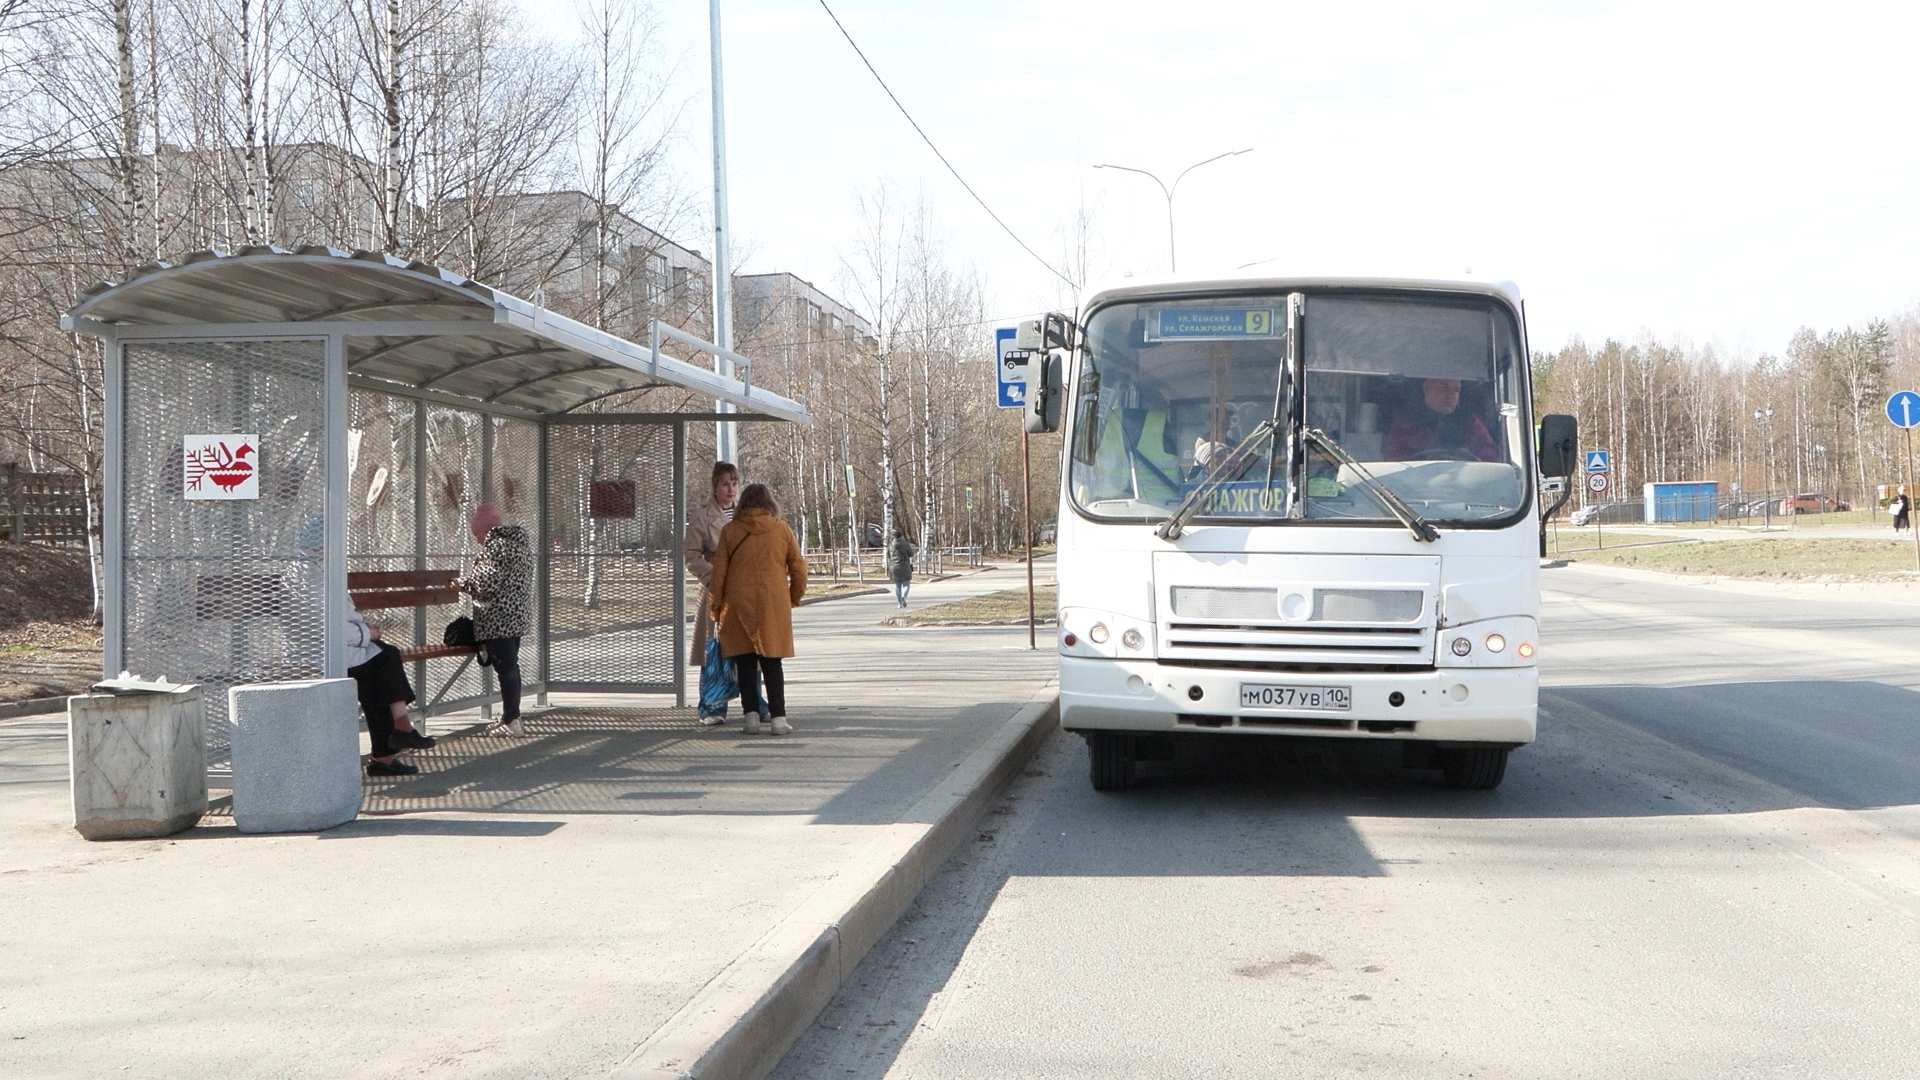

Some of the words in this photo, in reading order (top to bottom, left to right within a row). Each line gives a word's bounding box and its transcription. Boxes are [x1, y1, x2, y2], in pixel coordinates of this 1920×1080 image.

[1179, 323, 1243, 332] Сулажгорская
[1252, 313, 1263, 331] 9
[1593, 479, 1604, 487] 20
[1326, 689, 1343, 702] 10
